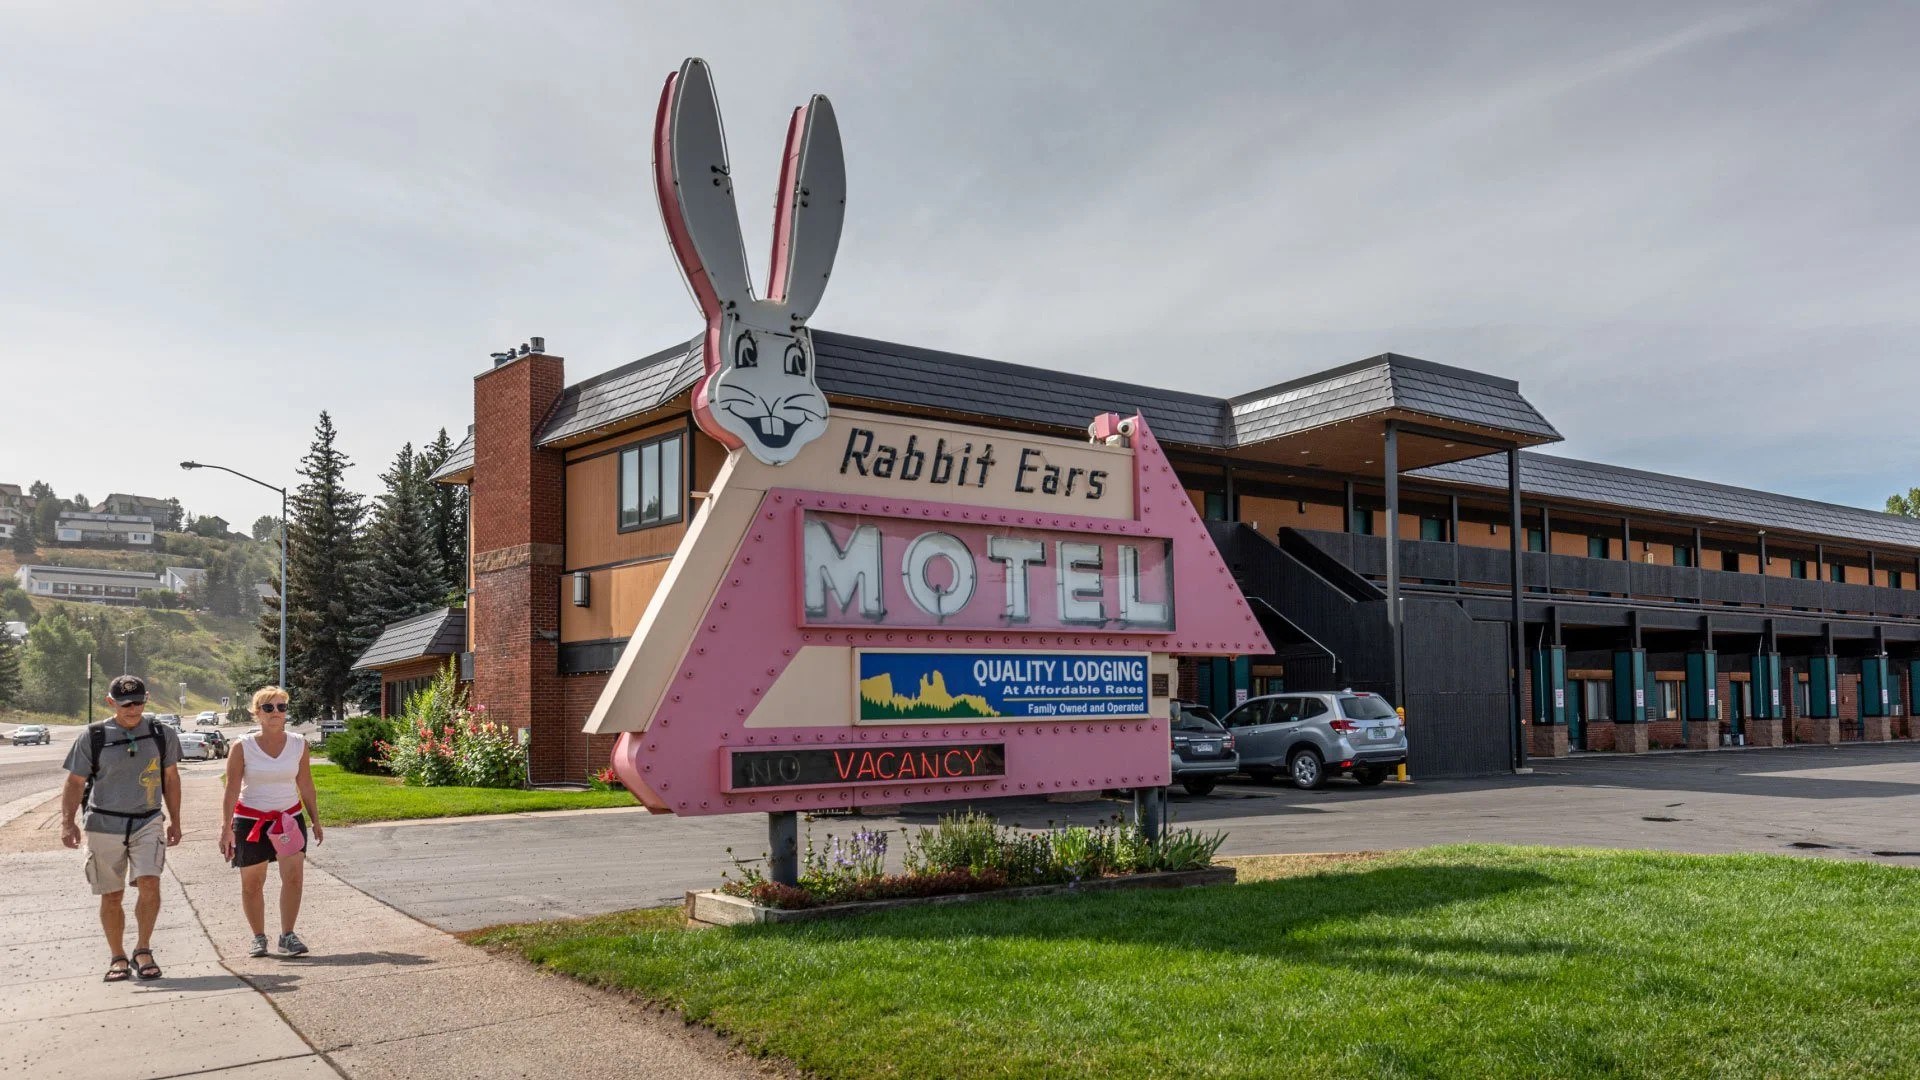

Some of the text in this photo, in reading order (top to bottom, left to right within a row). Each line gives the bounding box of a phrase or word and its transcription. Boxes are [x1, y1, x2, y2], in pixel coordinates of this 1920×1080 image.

[839, 427, 1108, 500] Rabbit Ears
[804, 519, 1169, 627] MOTEL
[973, 659, 1144, 687] QUALITY LODGING
[1003, 685, 1020, 695] At
[1024, 685, 1100, 695] Affordable
[1105, 685, 1144, 694] Rates
[1028, 702, 1145, 715] Family Owned and Operated
[750, 749, 983, 785] NO VACANCY
